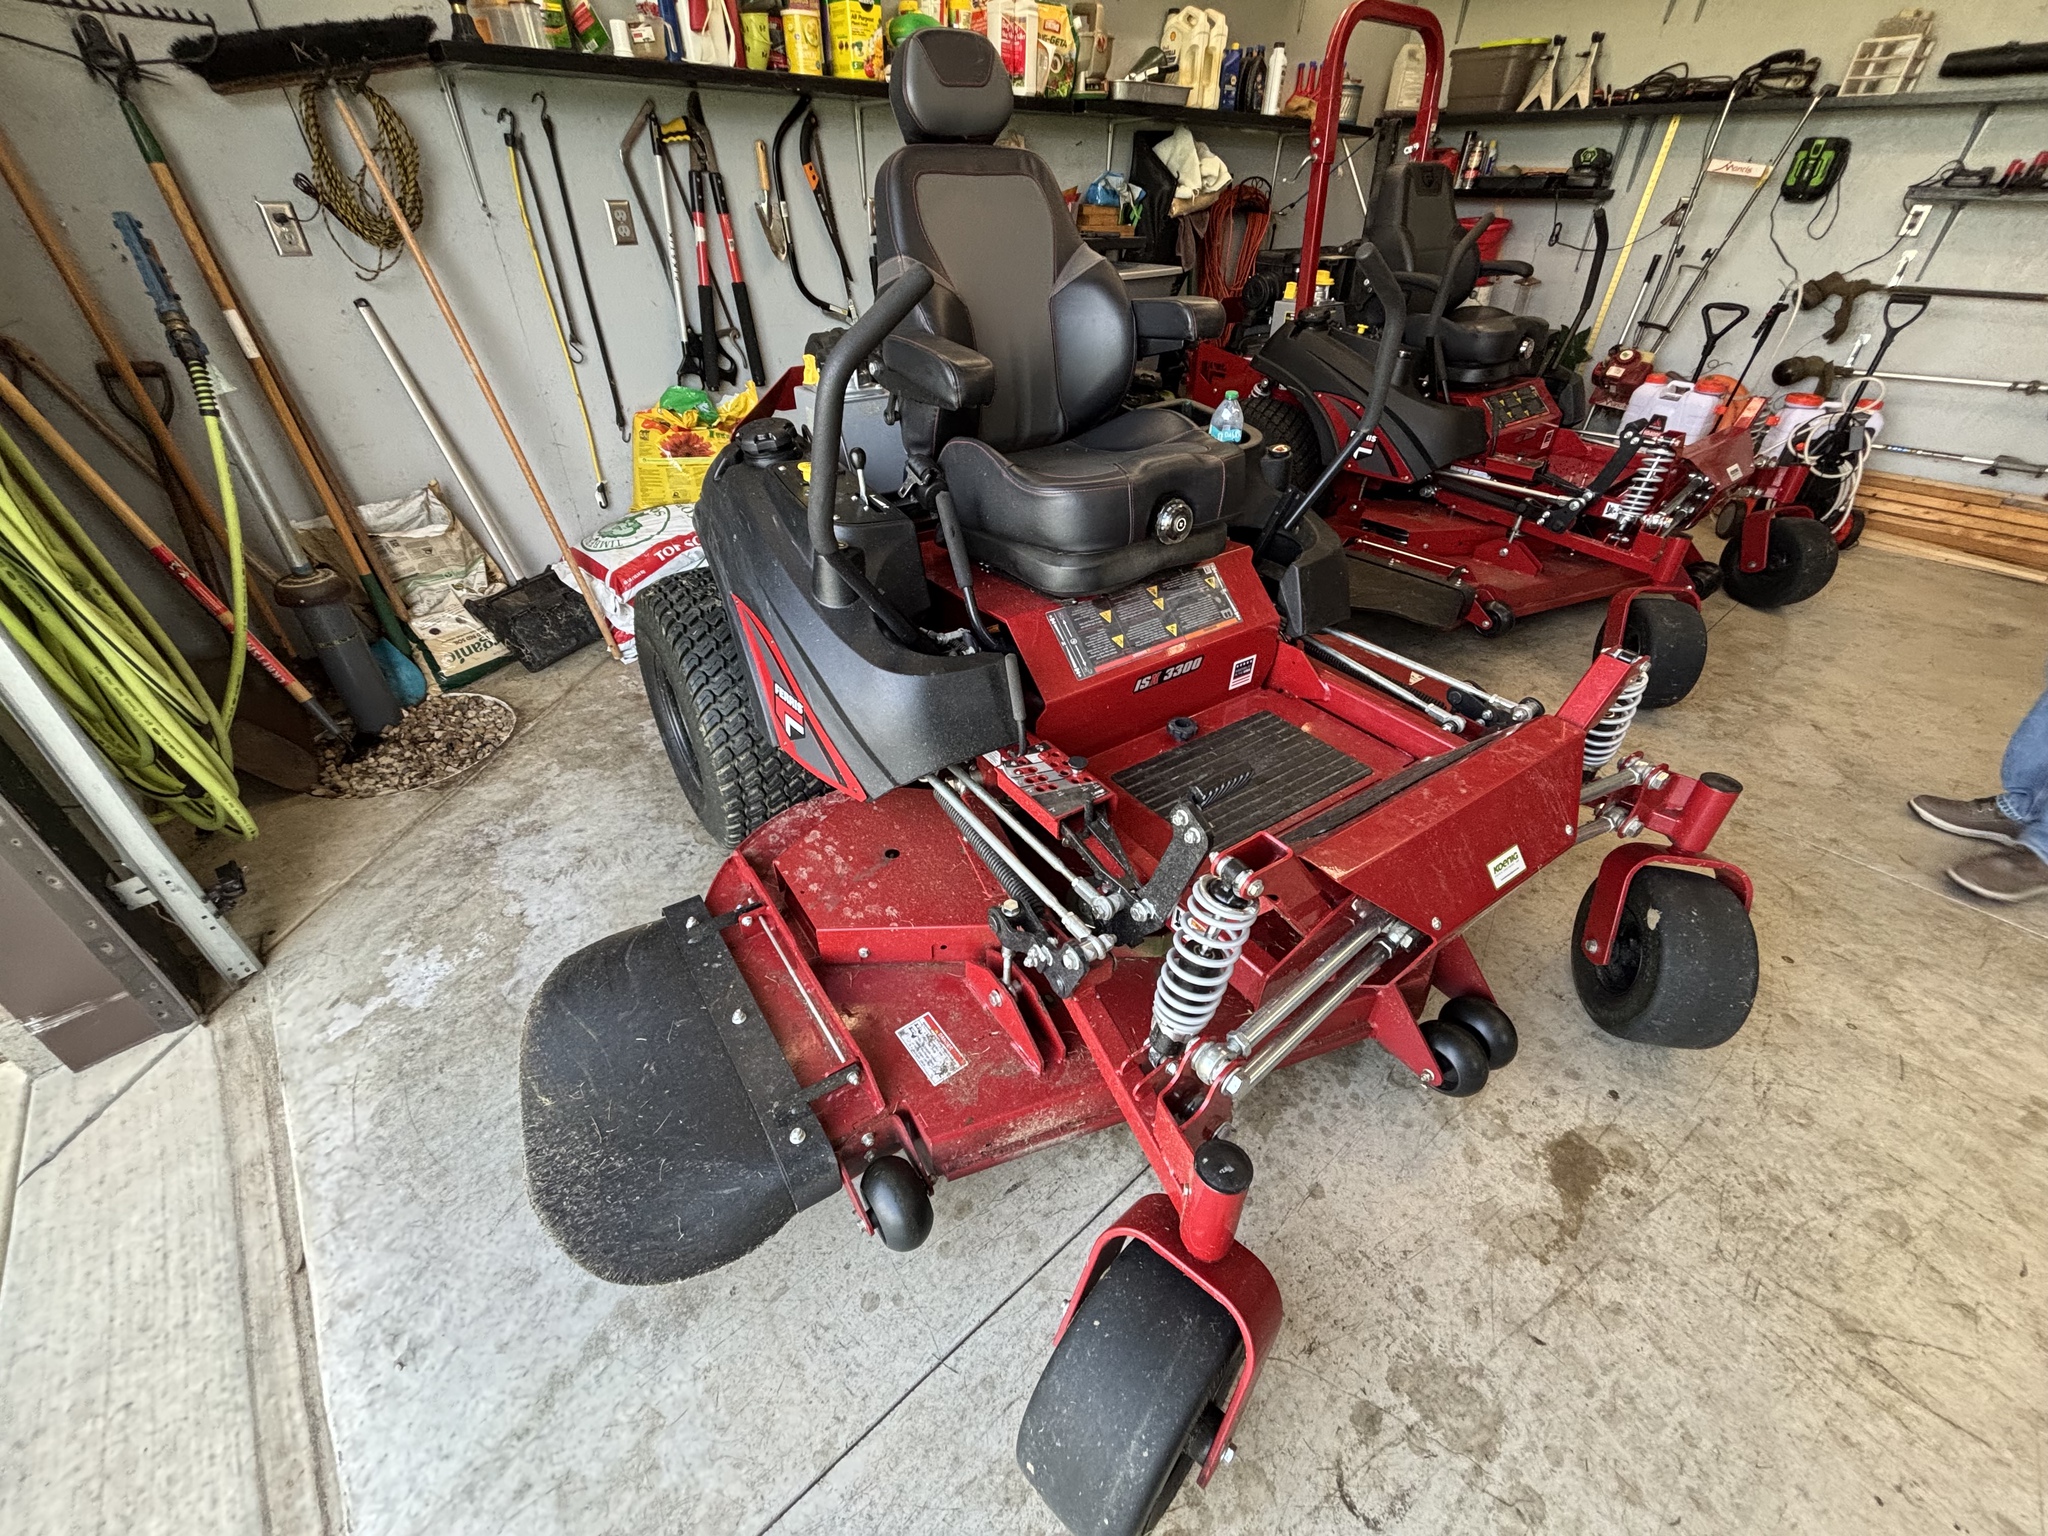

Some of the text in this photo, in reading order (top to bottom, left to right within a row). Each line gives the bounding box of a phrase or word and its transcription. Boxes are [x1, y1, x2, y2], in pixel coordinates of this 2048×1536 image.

[1713, 161, 1753, 174] Mantis
[1163, 657, 1203, 681] 3300
[774, 683, 804, 715] FERRIS
